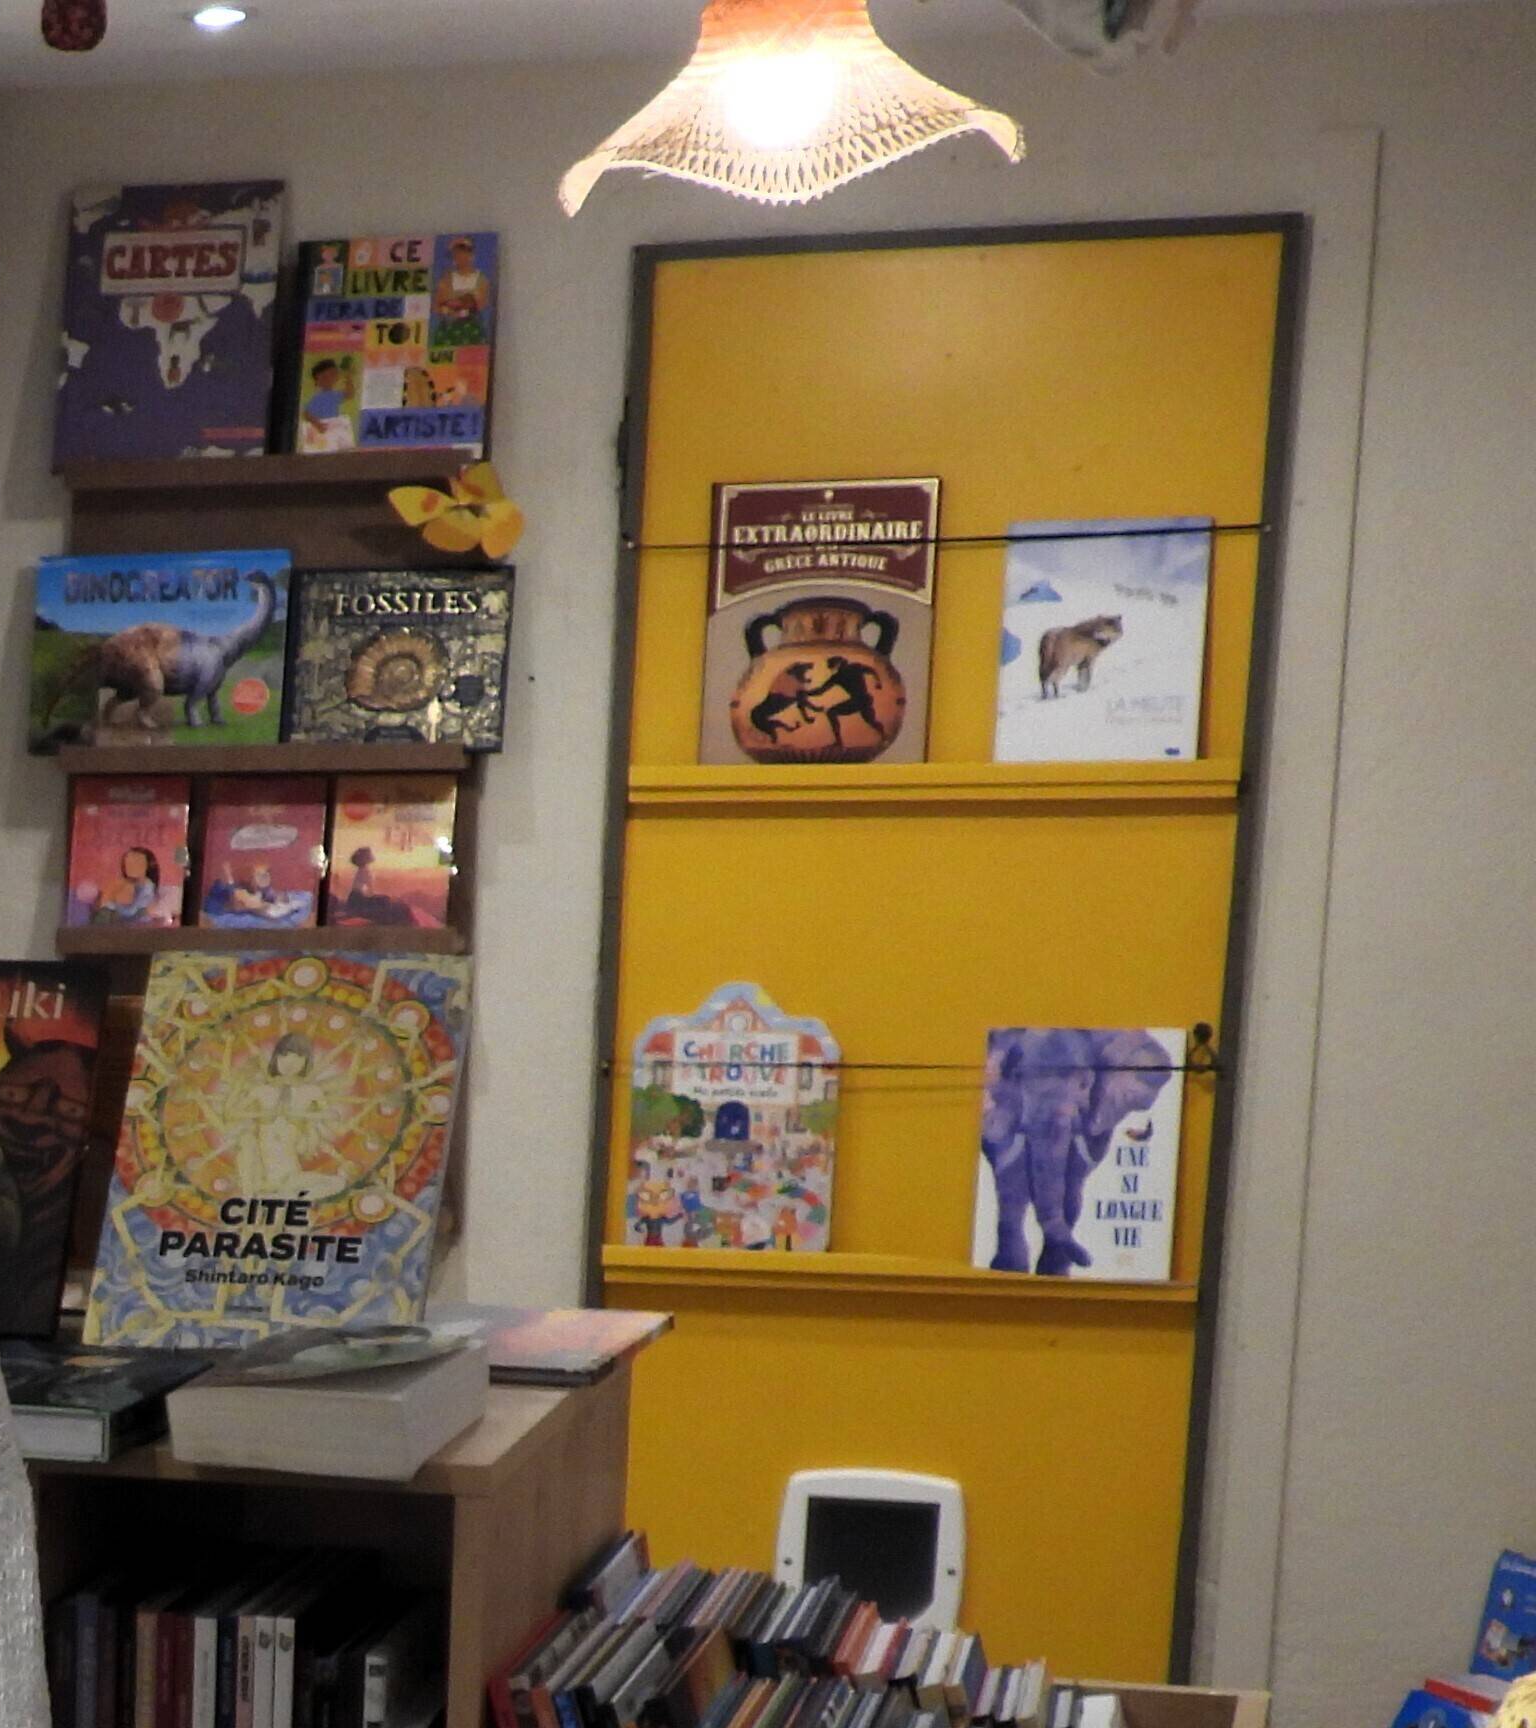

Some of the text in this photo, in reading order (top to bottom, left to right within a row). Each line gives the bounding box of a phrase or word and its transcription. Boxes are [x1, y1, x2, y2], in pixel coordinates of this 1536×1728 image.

[105, 241, 239, 280] CARTES
[390, 240, 421, 263] CE
[351, 268, 427, 295] LIVRE
[732, 520, 924, 545] EXTRAORDINAIRE
[334, 588, 479, 616] FOSSILES
[220, 1189, 312, 1227] CITÉ
[160, 1231, 362, 1265] PARASITE
[273, 1271, 325, 1291] Kago
